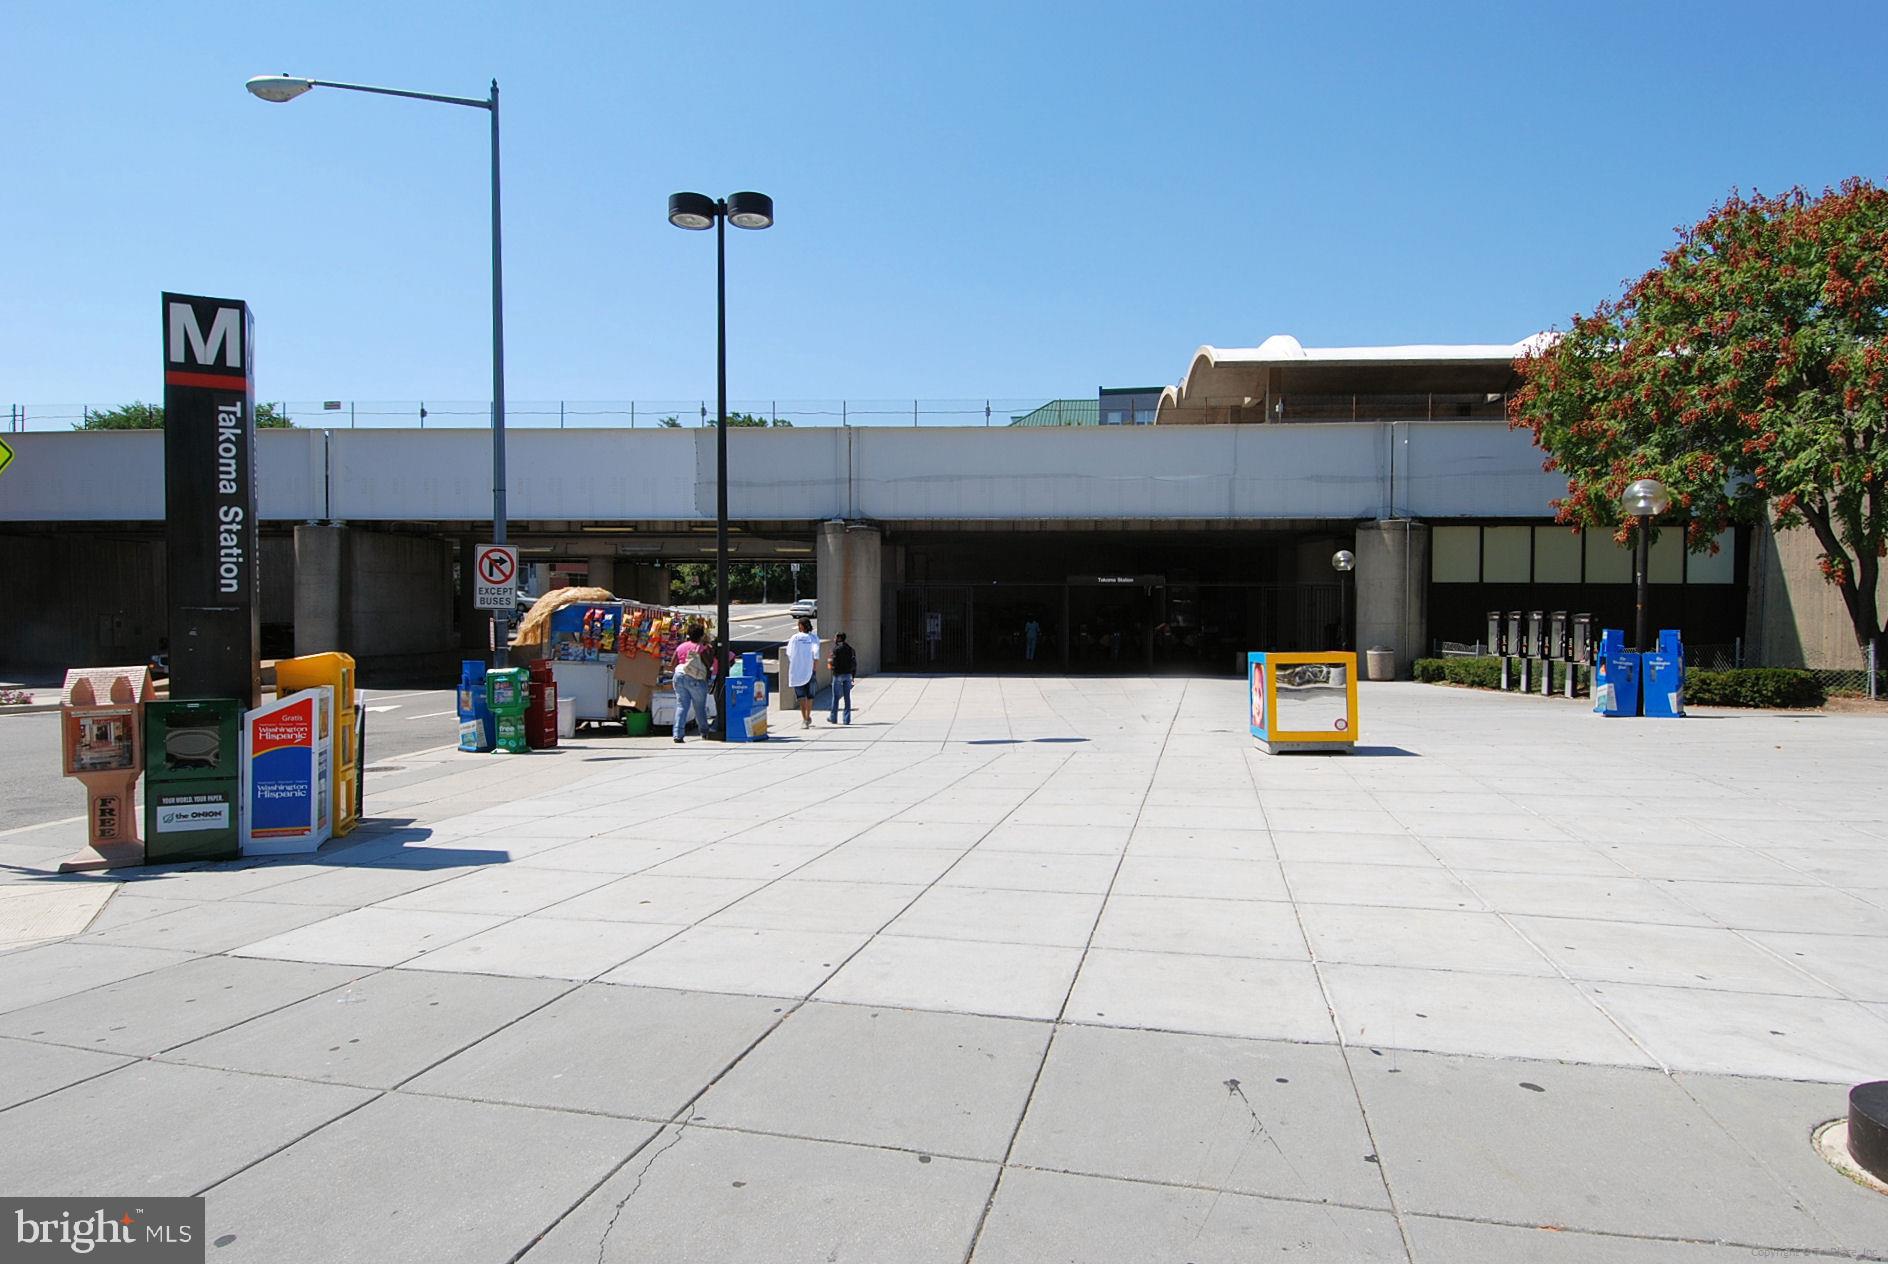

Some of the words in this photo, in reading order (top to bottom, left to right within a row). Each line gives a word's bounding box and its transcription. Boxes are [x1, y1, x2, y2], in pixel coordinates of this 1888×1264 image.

[169, 302, 242, 368] M
[217, 401, 242, 495] Takoma
[218, 505, 244, 593] Station
[478, 587, 513, 596] EXCEPT
[479, 597, 512, 606] BUSES
[281, 714, 303, 722] Gratis
[259, 732, 307, 740] Hispanic
[256, 783, 308, 791] Washington
[257, 790, 307, 799] Hispanic
[99, 798, 117, 837] FREE
[191, 810, 223, 818] ONION
